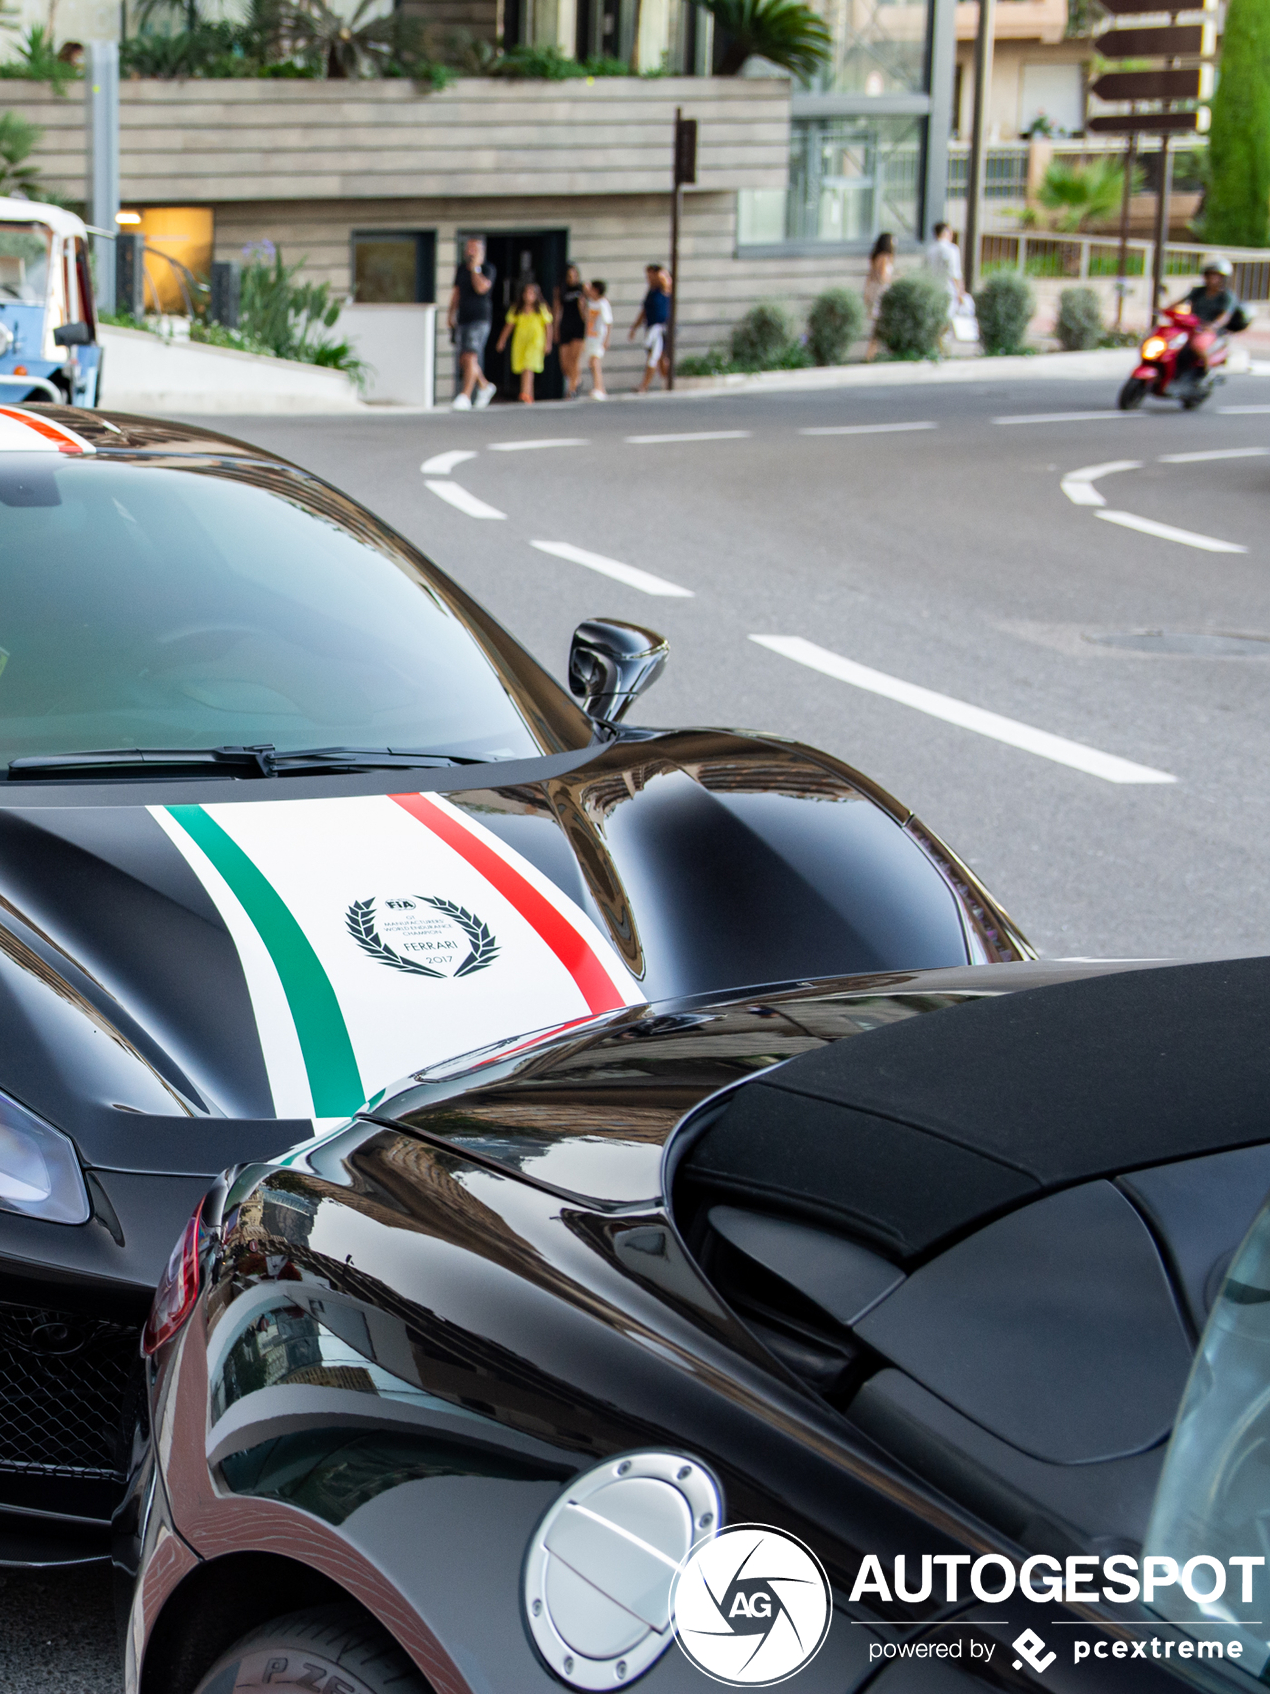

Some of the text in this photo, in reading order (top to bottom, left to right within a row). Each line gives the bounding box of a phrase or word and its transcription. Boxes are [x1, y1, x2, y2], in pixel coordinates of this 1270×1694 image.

[403, 940, 458, 951] FERRARI
[425, 955, 453, 964] 2017
[262, 1657, 288, 1684] P
